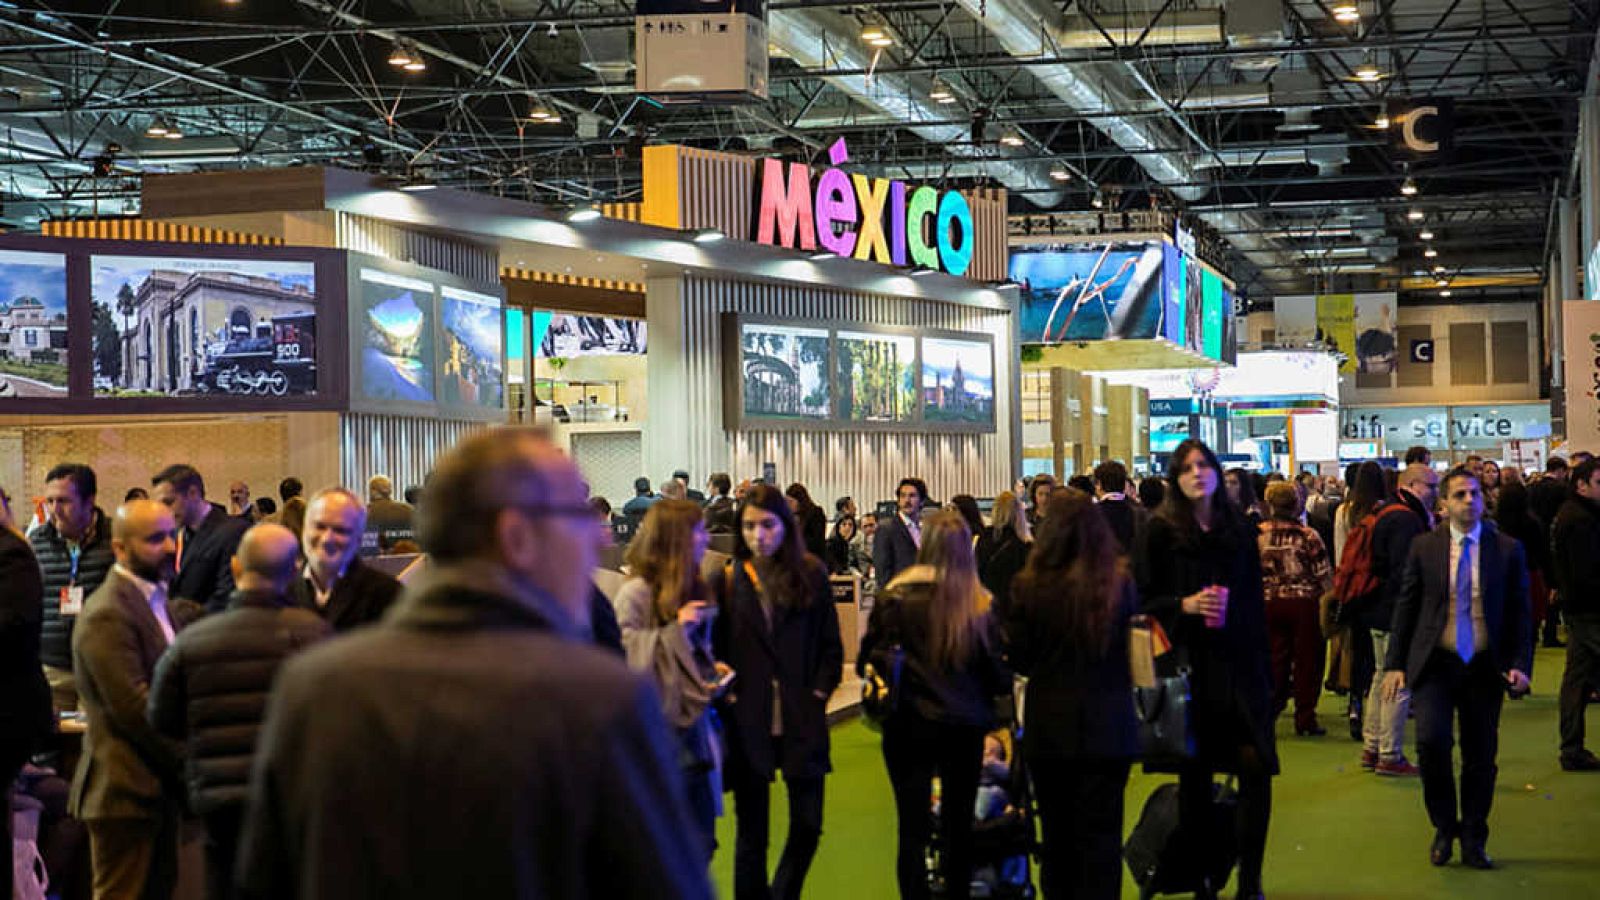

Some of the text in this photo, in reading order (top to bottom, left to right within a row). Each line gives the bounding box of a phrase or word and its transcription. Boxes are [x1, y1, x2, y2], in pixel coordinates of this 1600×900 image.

[1403, 106, 1439, 151] C
[1415, 343, 1429, 360] C
[1413, 413, 1512, 437] sevice
